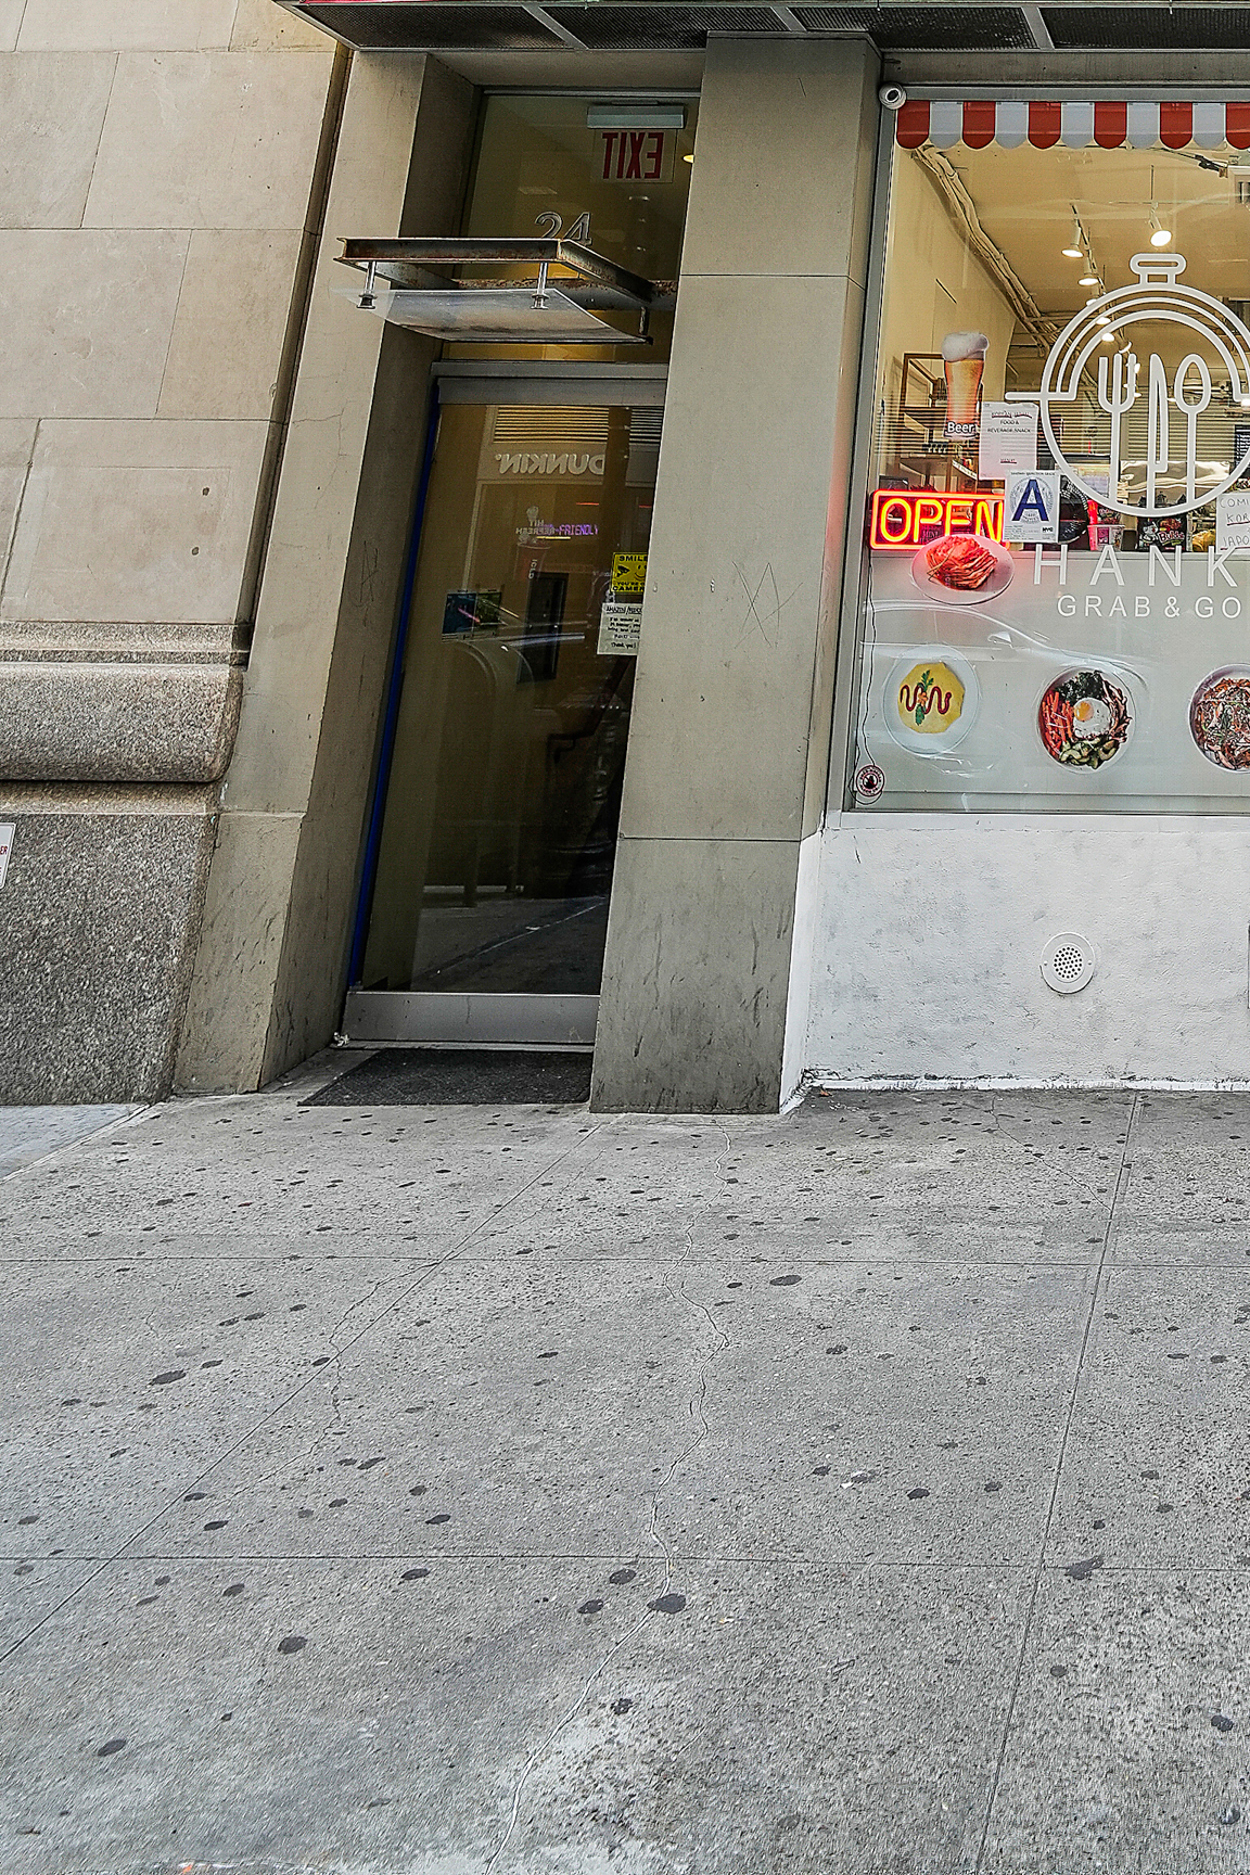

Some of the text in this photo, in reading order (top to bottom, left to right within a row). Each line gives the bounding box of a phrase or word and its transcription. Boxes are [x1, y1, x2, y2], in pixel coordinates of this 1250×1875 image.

[534, 211, 592, 246] 24
[947, 421, 974, 434] Beer
[1011, 479, 1050, 521] A
[880, 498, 1004, 543] OPEN
[1057, 595, 1241, 619] GRAB & GO
